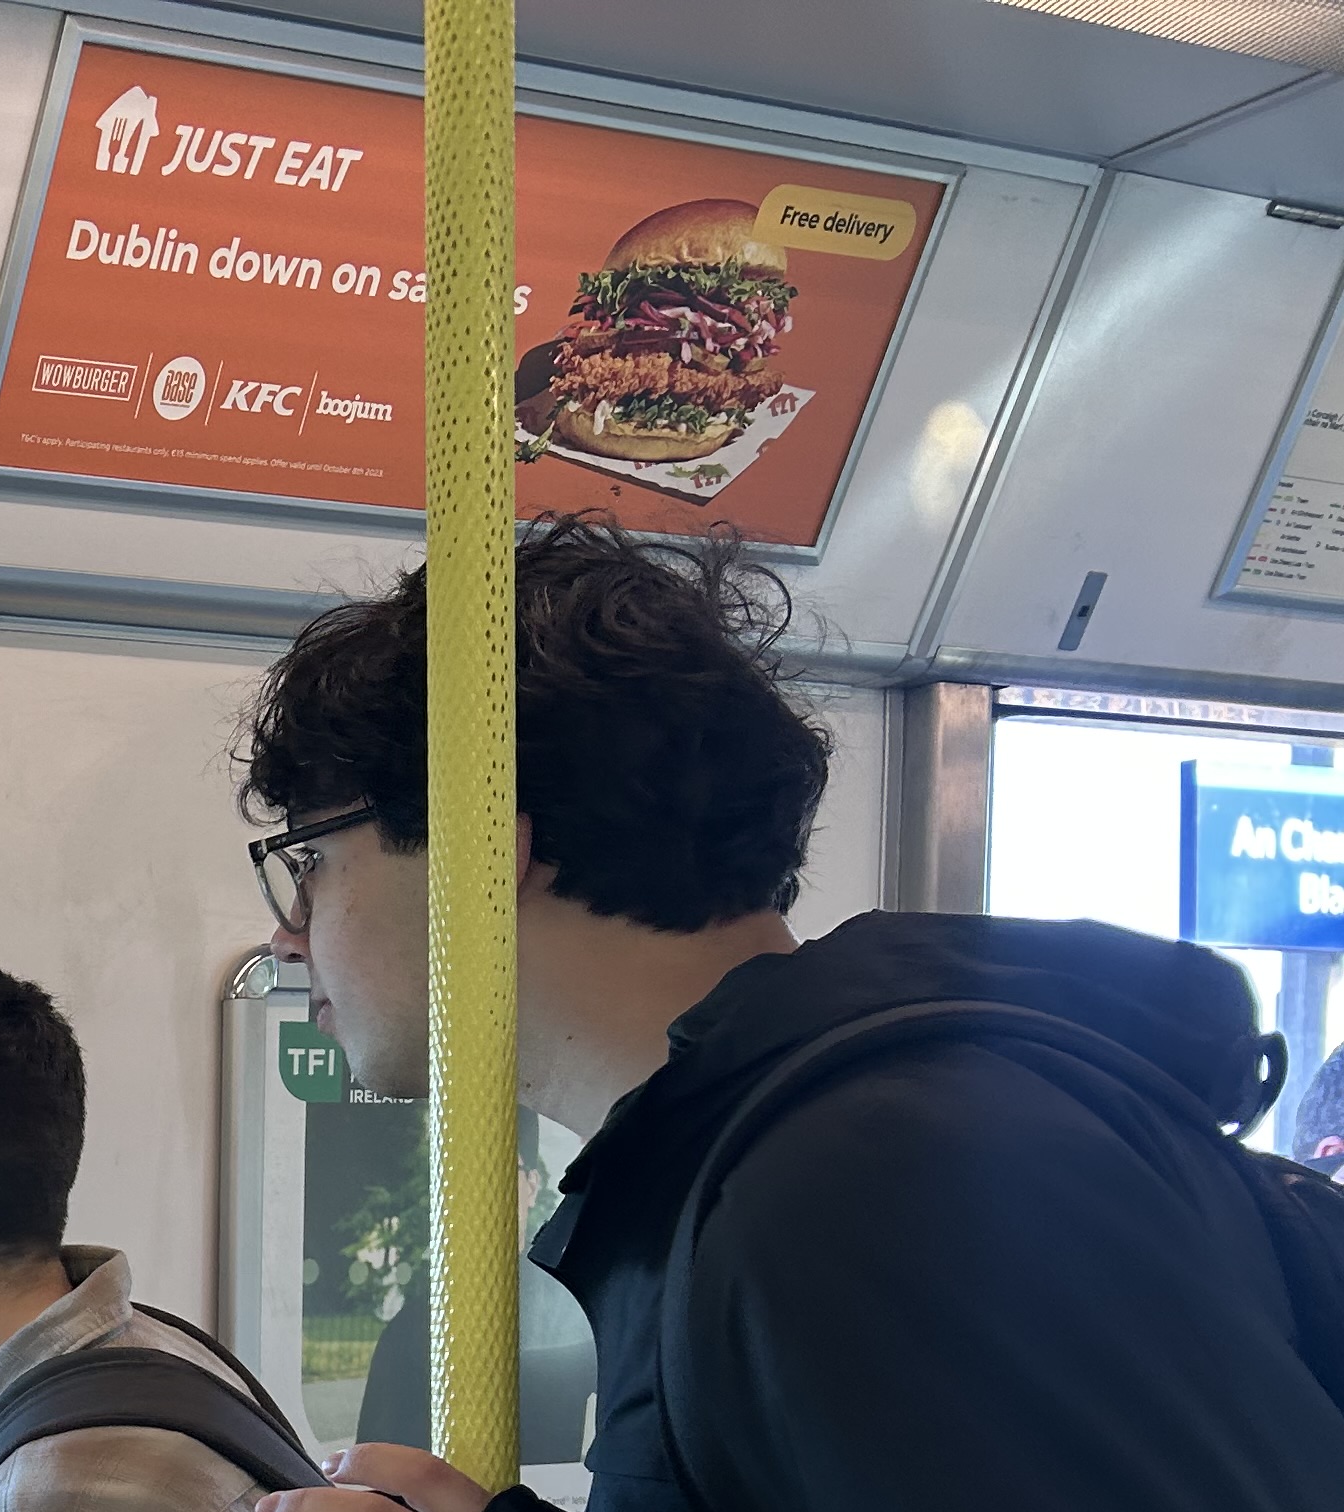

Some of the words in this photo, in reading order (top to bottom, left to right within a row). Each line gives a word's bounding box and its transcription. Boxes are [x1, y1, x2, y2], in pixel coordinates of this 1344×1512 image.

[161, 125, 276, 180] JUST
[274, 141, 364, 192] EAT
[780, 205, 820, 229] Free
[823, 210, 895, 245] delivery
[66, 219, 199, 275] Dublin
[208, 237, 323, 290] down
[331, 262, 382, 297] on
[40, 361, 130, 394] WOWBURGER
[220, 379, 303, 416] KFC
[316, 390, 393, 424] boojum
[65, 437, 111, 451] Participating
[111, 443, 152, 455] restaurants
[219, 454, 243, 464] spend
[270, 458, 289, 469] Offer
[289, 460, 306, 471] valid
[306, 462, 323, 472] until
[323, 463, 352, 475] October
[1231, 815, 1276, 859] An
[287, 1048, 336, 1076] TFI
